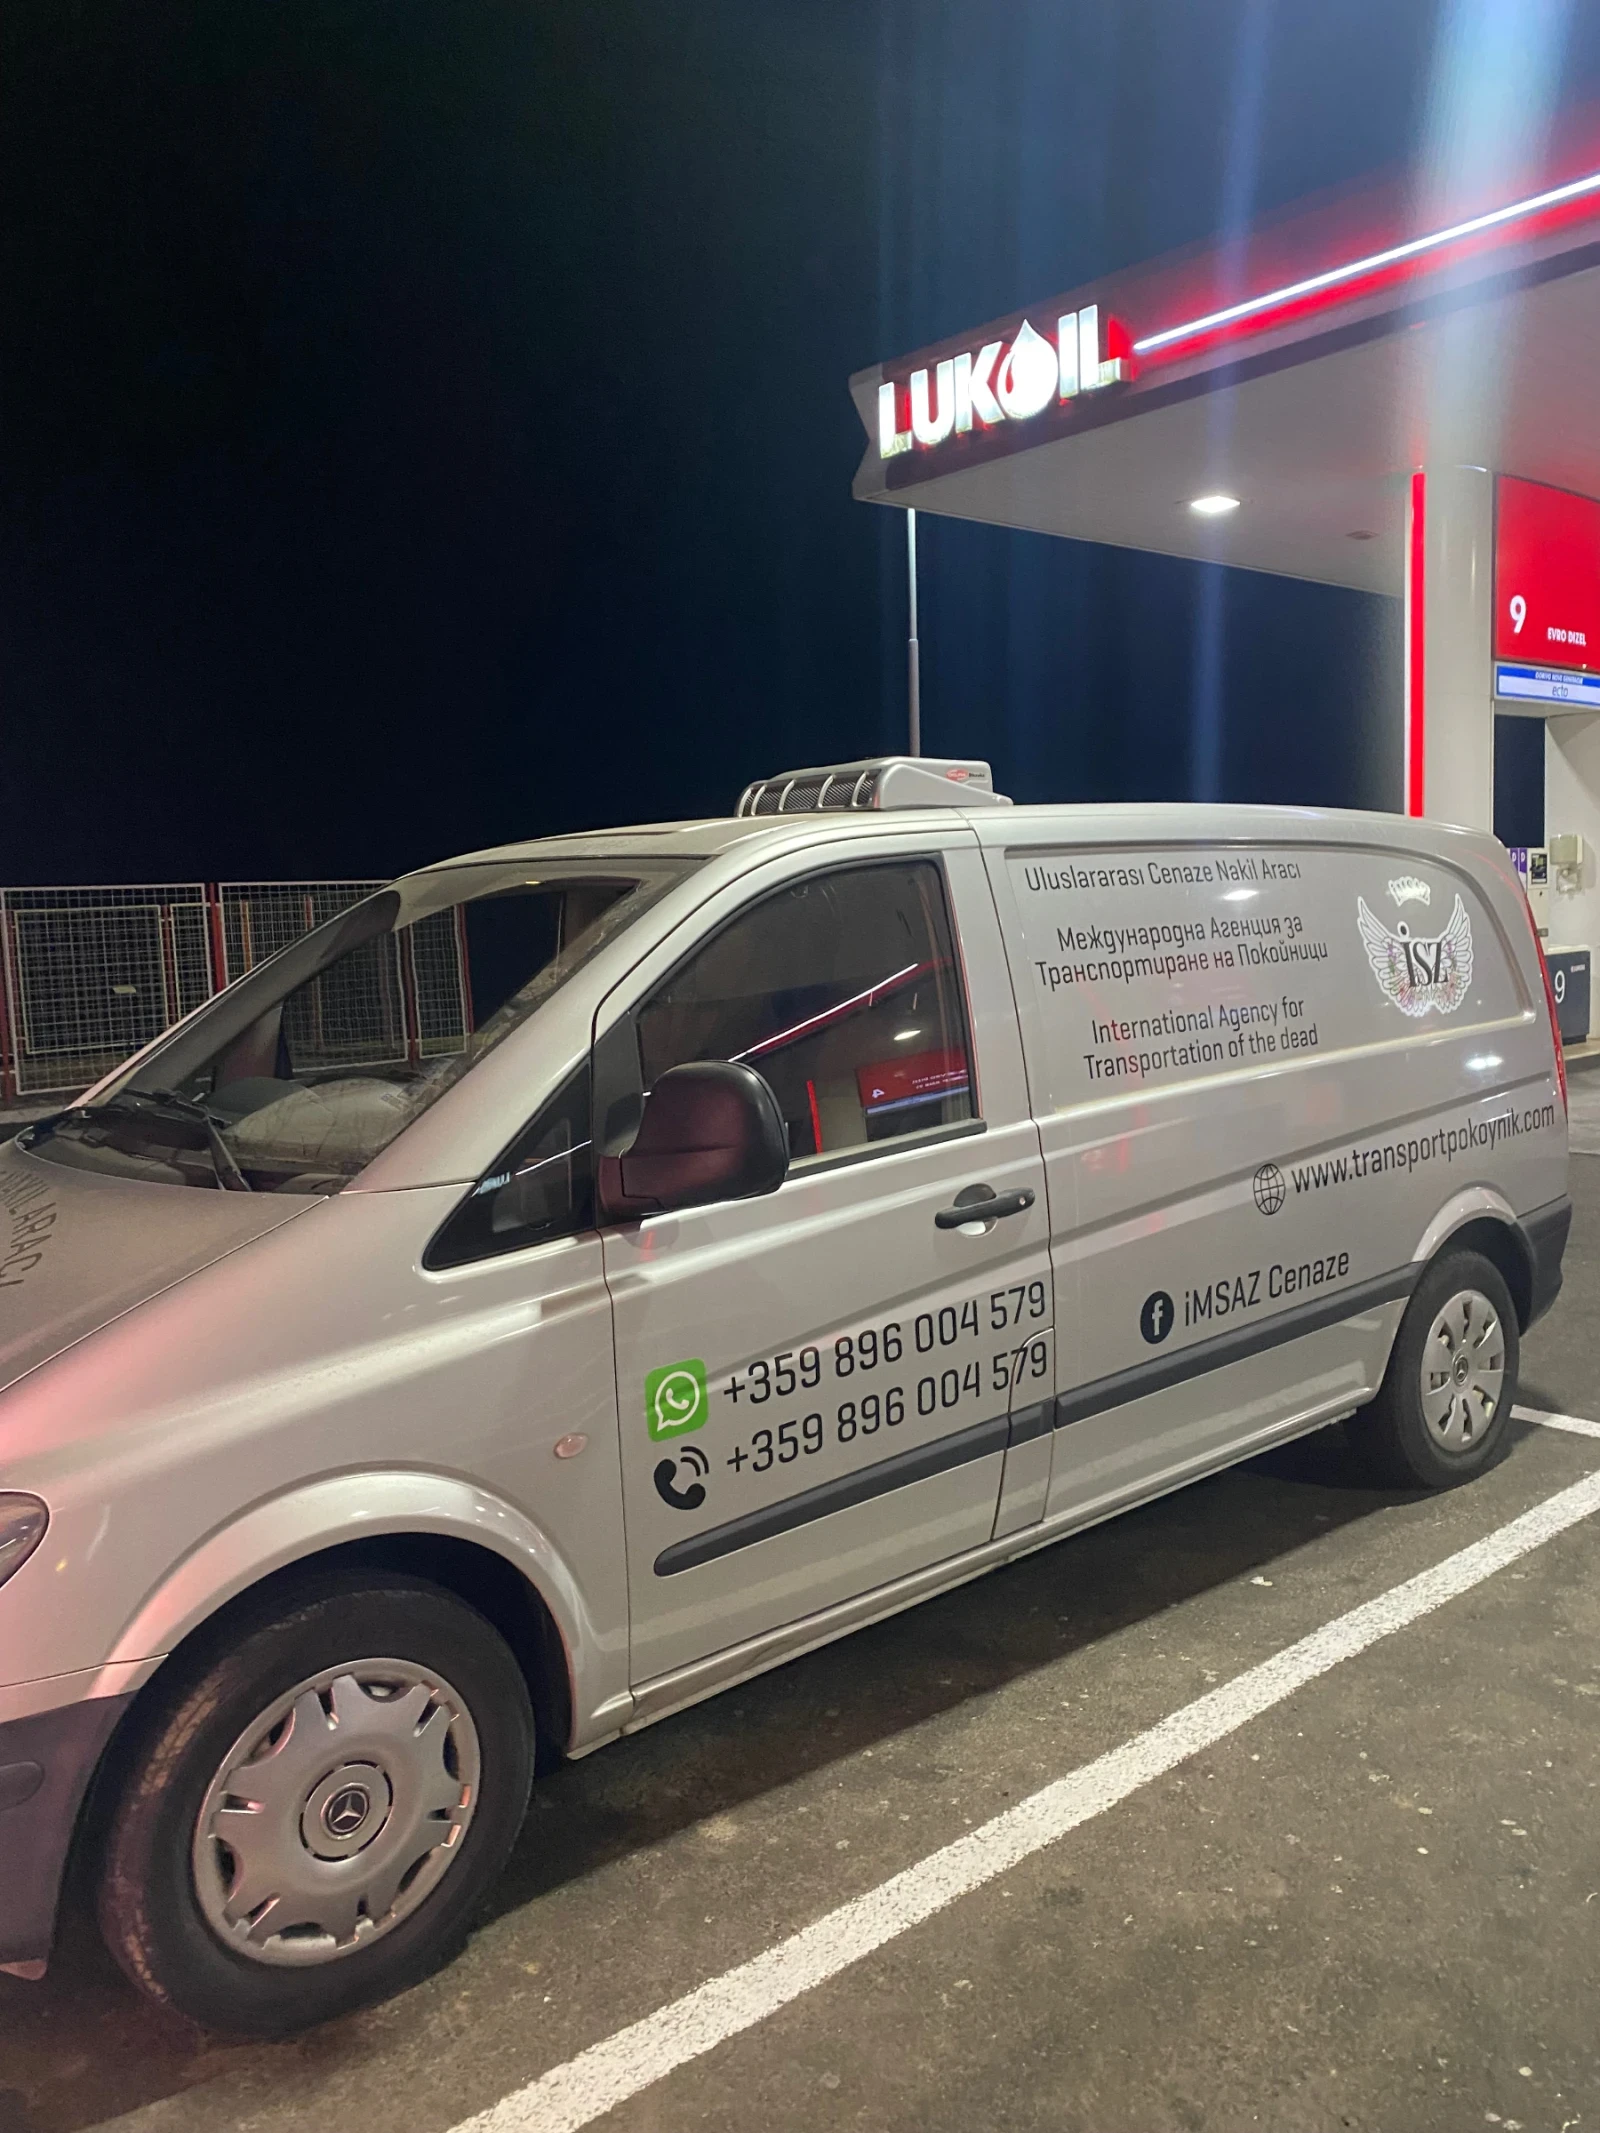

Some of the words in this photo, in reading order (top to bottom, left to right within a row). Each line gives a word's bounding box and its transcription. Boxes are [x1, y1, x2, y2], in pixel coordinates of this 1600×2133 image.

[878, 304, 1121, 459] LUKOIL
[1510, 595, 1527, 634] 9
[1547, 627, 1567, 642] EVRO
[1568, 630, 1587, 646] DIZEL
[1024, 865, 1145, 891] Uluslararası
[1148, 862, 1214, 885] Cenaze
[1215, 858, 1259, 882] Nakil
[1262, 859, 1302, 880] Aracı
[1057, 921, 1206, 954] Международна
[1210, 916, 1282, 941] Агенция
[1284, 916, 1303, 939] за
[1035, 953, 1209, 990] Транспортиране
[1213, 951, 1235, 969] на
[1237, 941, 1329, 966] Покойници
[1555, 970, 1566, 1004] 9
[1092, 1005, 1214, 1044] International
[1219, 1003, 1279, 1032] Agency
[1282, 995, 1304, 1019] for
[1083, 1039, 1224, 1080] Transportation
[1228, 1033, 1245, 1058] of
[1248, 1030, 1276, 1055] the
[1280, 1023, 1319, 1050] dead
[1291, 1104, 1555, 1193] www.transportpokoynik.com
[1184, 1270, 1261, 1327] iMSAZ
[1269, 1252, 1349, 1299] Cenaze
[723, 1346, 821, 1405] +359
[835, 1322, 902, 1378] 896
[914, 1300, 979, 1353] 004
[990, 1280, 1046, 1331] 579
[726, 1412, 824, 1474] +359
[837, 1387, 905, 1443] 896
[917, 1361, 981, 1416] 004
[992, 1341, 1048, 1391] 579
